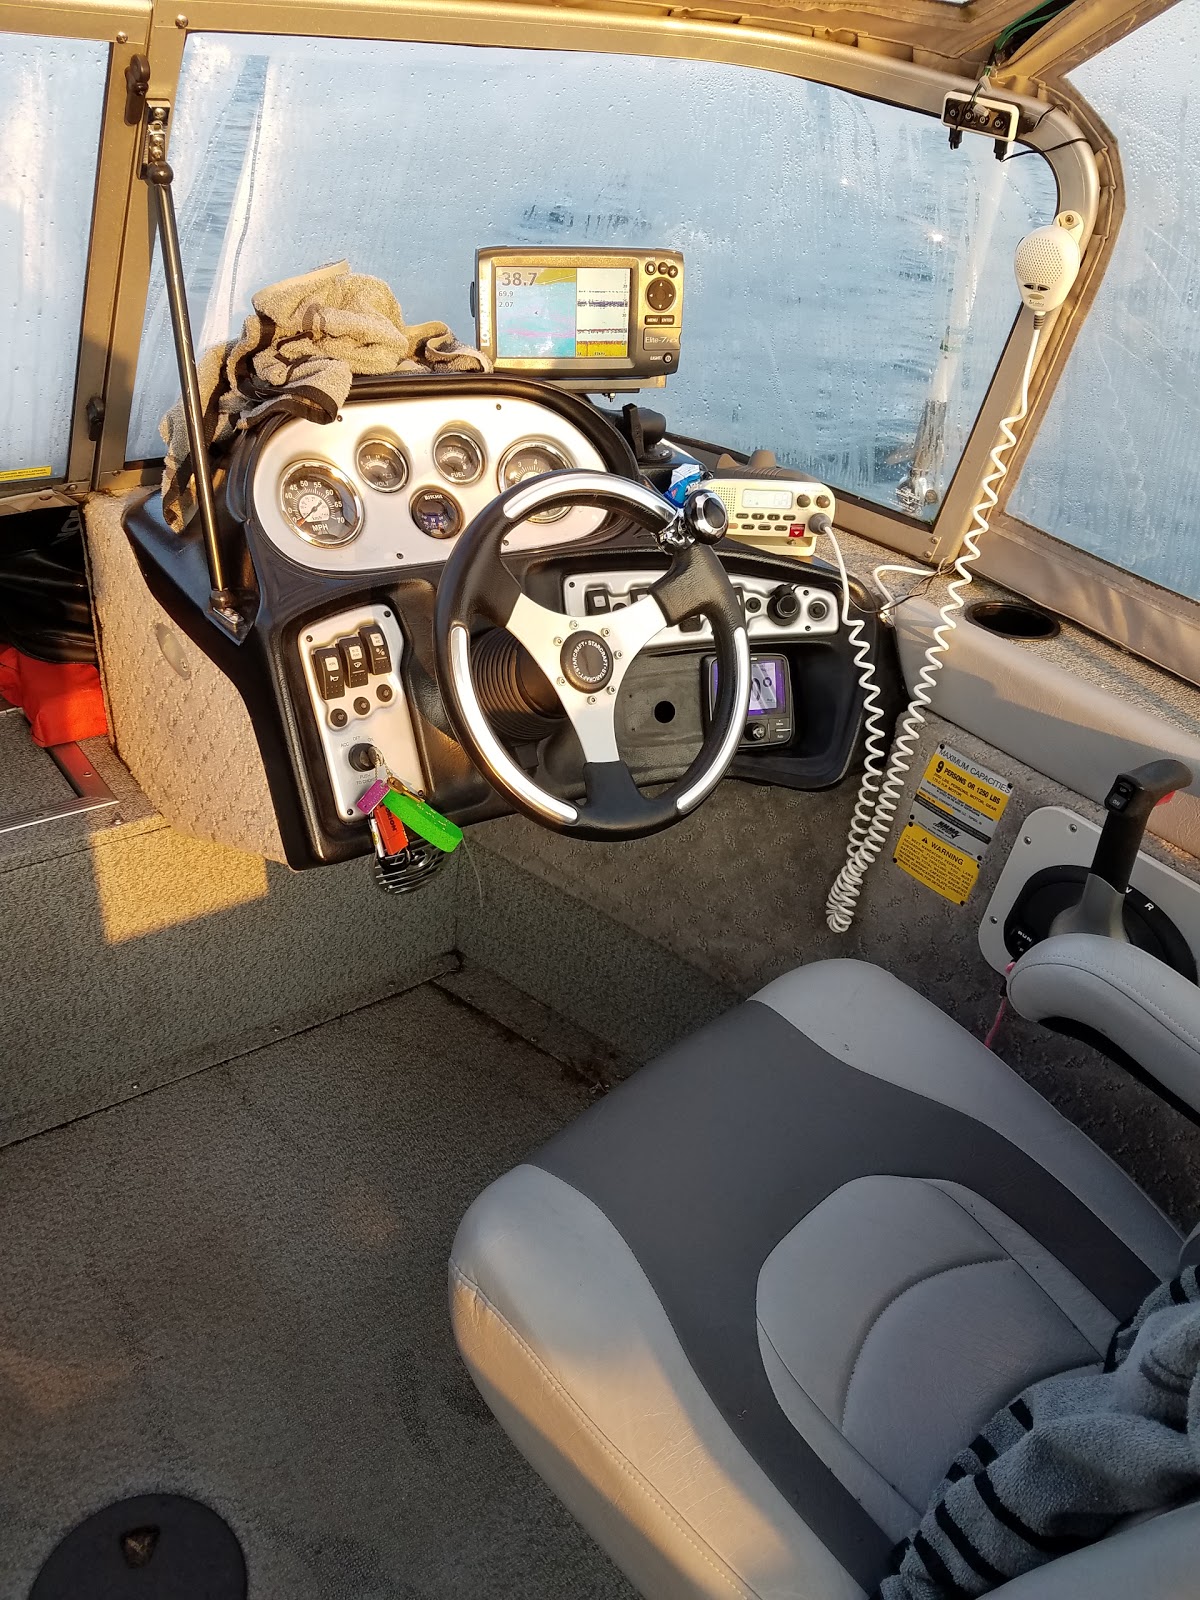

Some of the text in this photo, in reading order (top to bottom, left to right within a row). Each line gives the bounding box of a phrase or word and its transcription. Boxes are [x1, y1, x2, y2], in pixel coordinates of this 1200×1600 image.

[502, 272, 538, 286] 38.7
[572, 641, 586, 673] STARCRAFT
[587, 640, 608, 667] STARCRAFT
[935, 760, 945, 774] 9
[943, 767, 967, 784] PERSONS
[966, 781, 975, 790] OR
[975, 787, 989, 797] 1250
[989, 794, 1000, 804] LBS
[939, 749, 1011, 794] MAXIMUM CAPACITIES
[948, 787, 961, 796] MOTOR
[930, 841, 964, 865] WARNING
[1144, 902, 1155, 912] R
[1018, 930, 1032, 942] RUN
